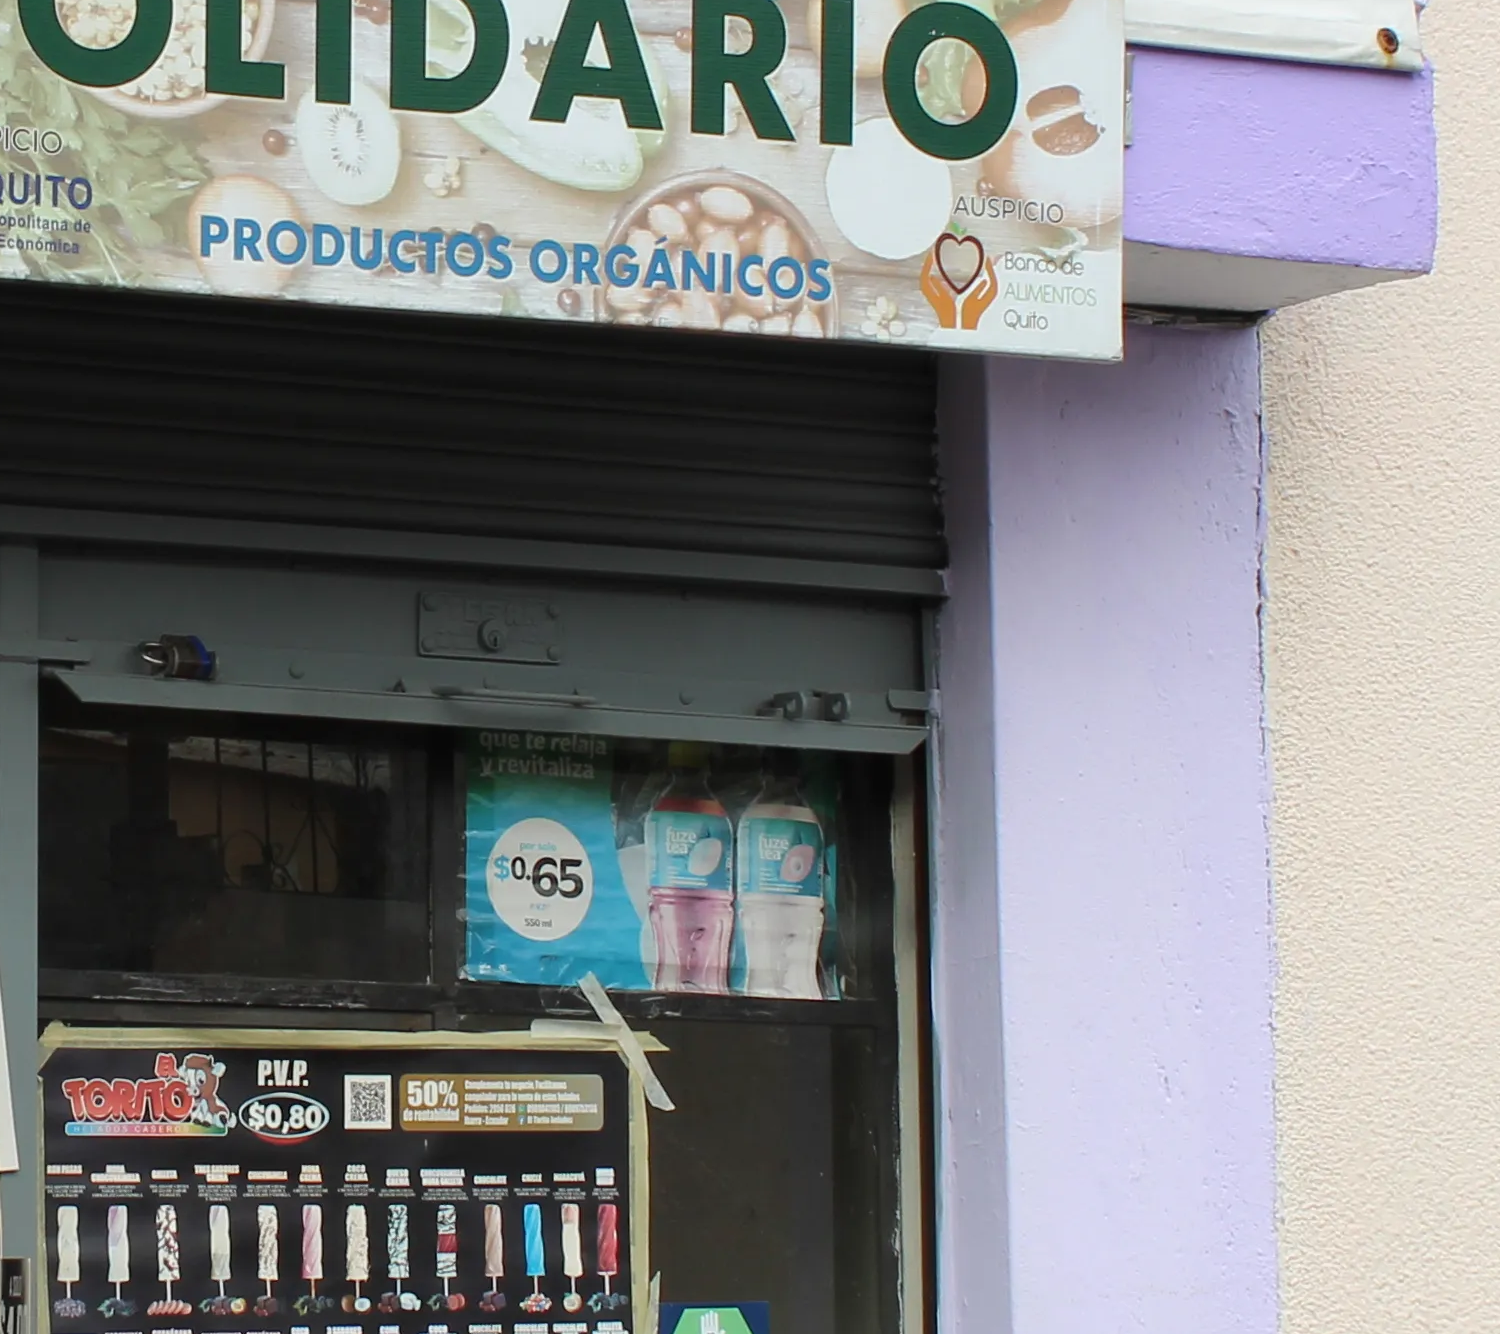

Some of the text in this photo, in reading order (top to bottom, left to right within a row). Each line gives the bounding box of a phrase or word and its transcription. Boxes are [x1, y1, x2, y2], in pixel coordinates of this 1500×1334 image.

[954, 196, 1063, 223] AUSPICIO
[74, 219, 91, 233] de
[200, 215, 833, 303] PRODUCTOS ORGÁNICOS
[1004, 251, 1084, 276] Banco de
[1004, 283, 1097, 306] ALIMENTOS
[1003, 309, 1048, 331] Quito
[525, 731, 546, 750] te
[498, 756, 594, 779] revitaliza
[493, 853, 584, 899] $0.65
[257, 1059, 308, 1087] P.V.P.
[62, 1078, 195, 1122] TORITO
[407, 1080, 458, 1107] 50%
[248, 1103, 322, 1134] $0,80
